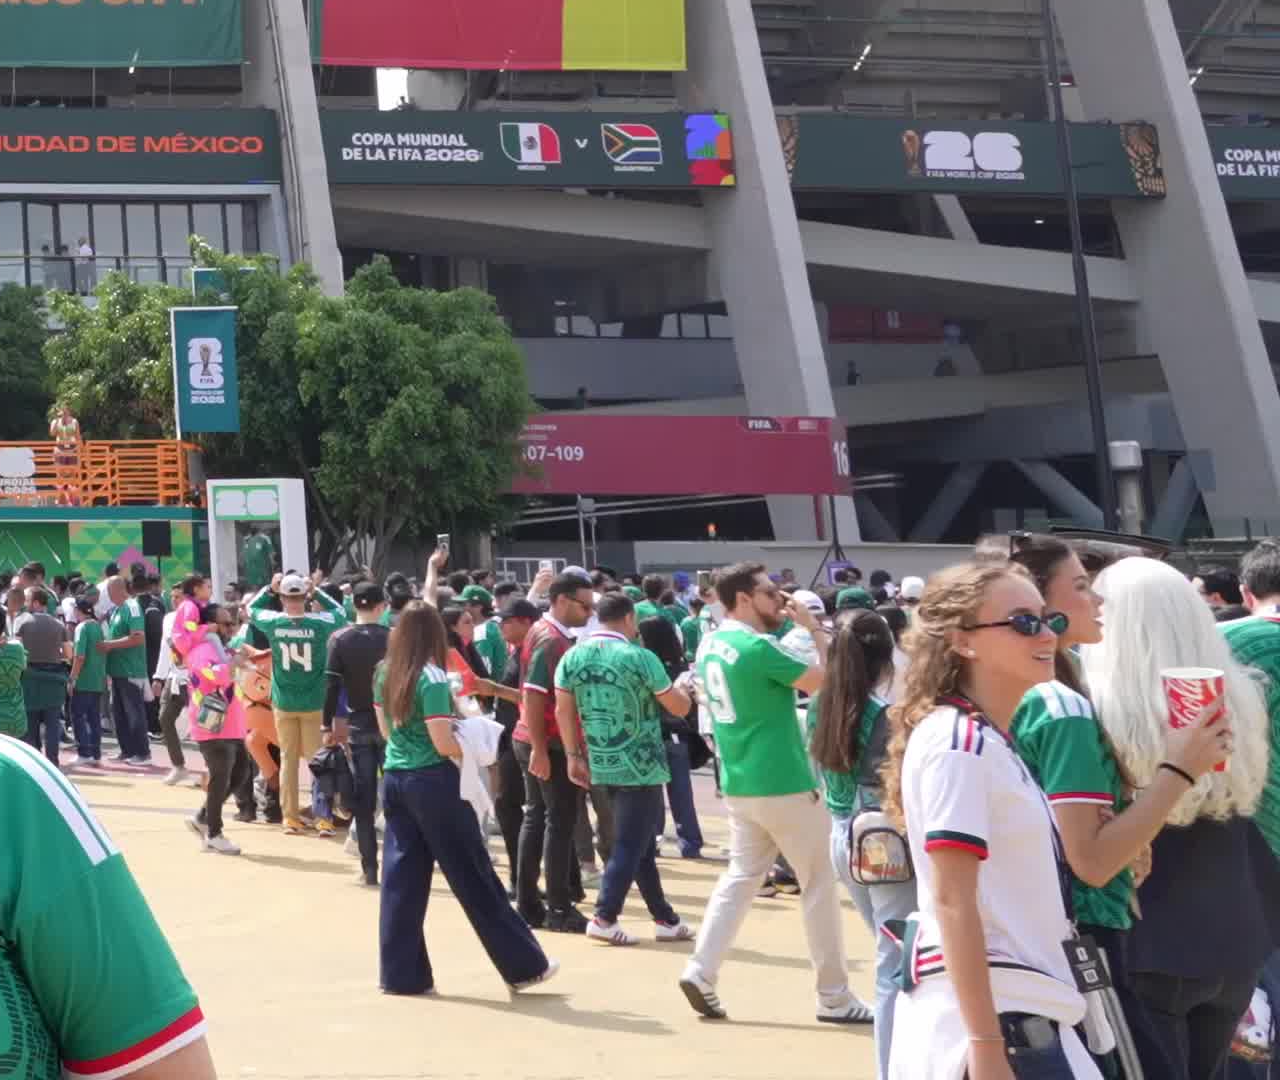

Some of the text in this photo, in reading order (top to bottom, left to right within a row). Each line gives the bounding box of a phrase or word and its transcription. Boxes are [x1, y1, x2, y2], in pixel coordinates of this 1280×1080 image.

[96, 135, 137, 153] DE
[143, 131, 263, 154] MÉXICO
[351, 132, 468, 147] COPA MUNDIAL
[342, 147, 480, 162] DE LA FIFA 2026
[923, 130, 1023, 171] 26
[1224, 148, 1264, 162] COPA
[1216, 163, 1280, 177] DE LA FIF
[833, 440, 850, 476] 16
[279, 641, 313, 672] 14
